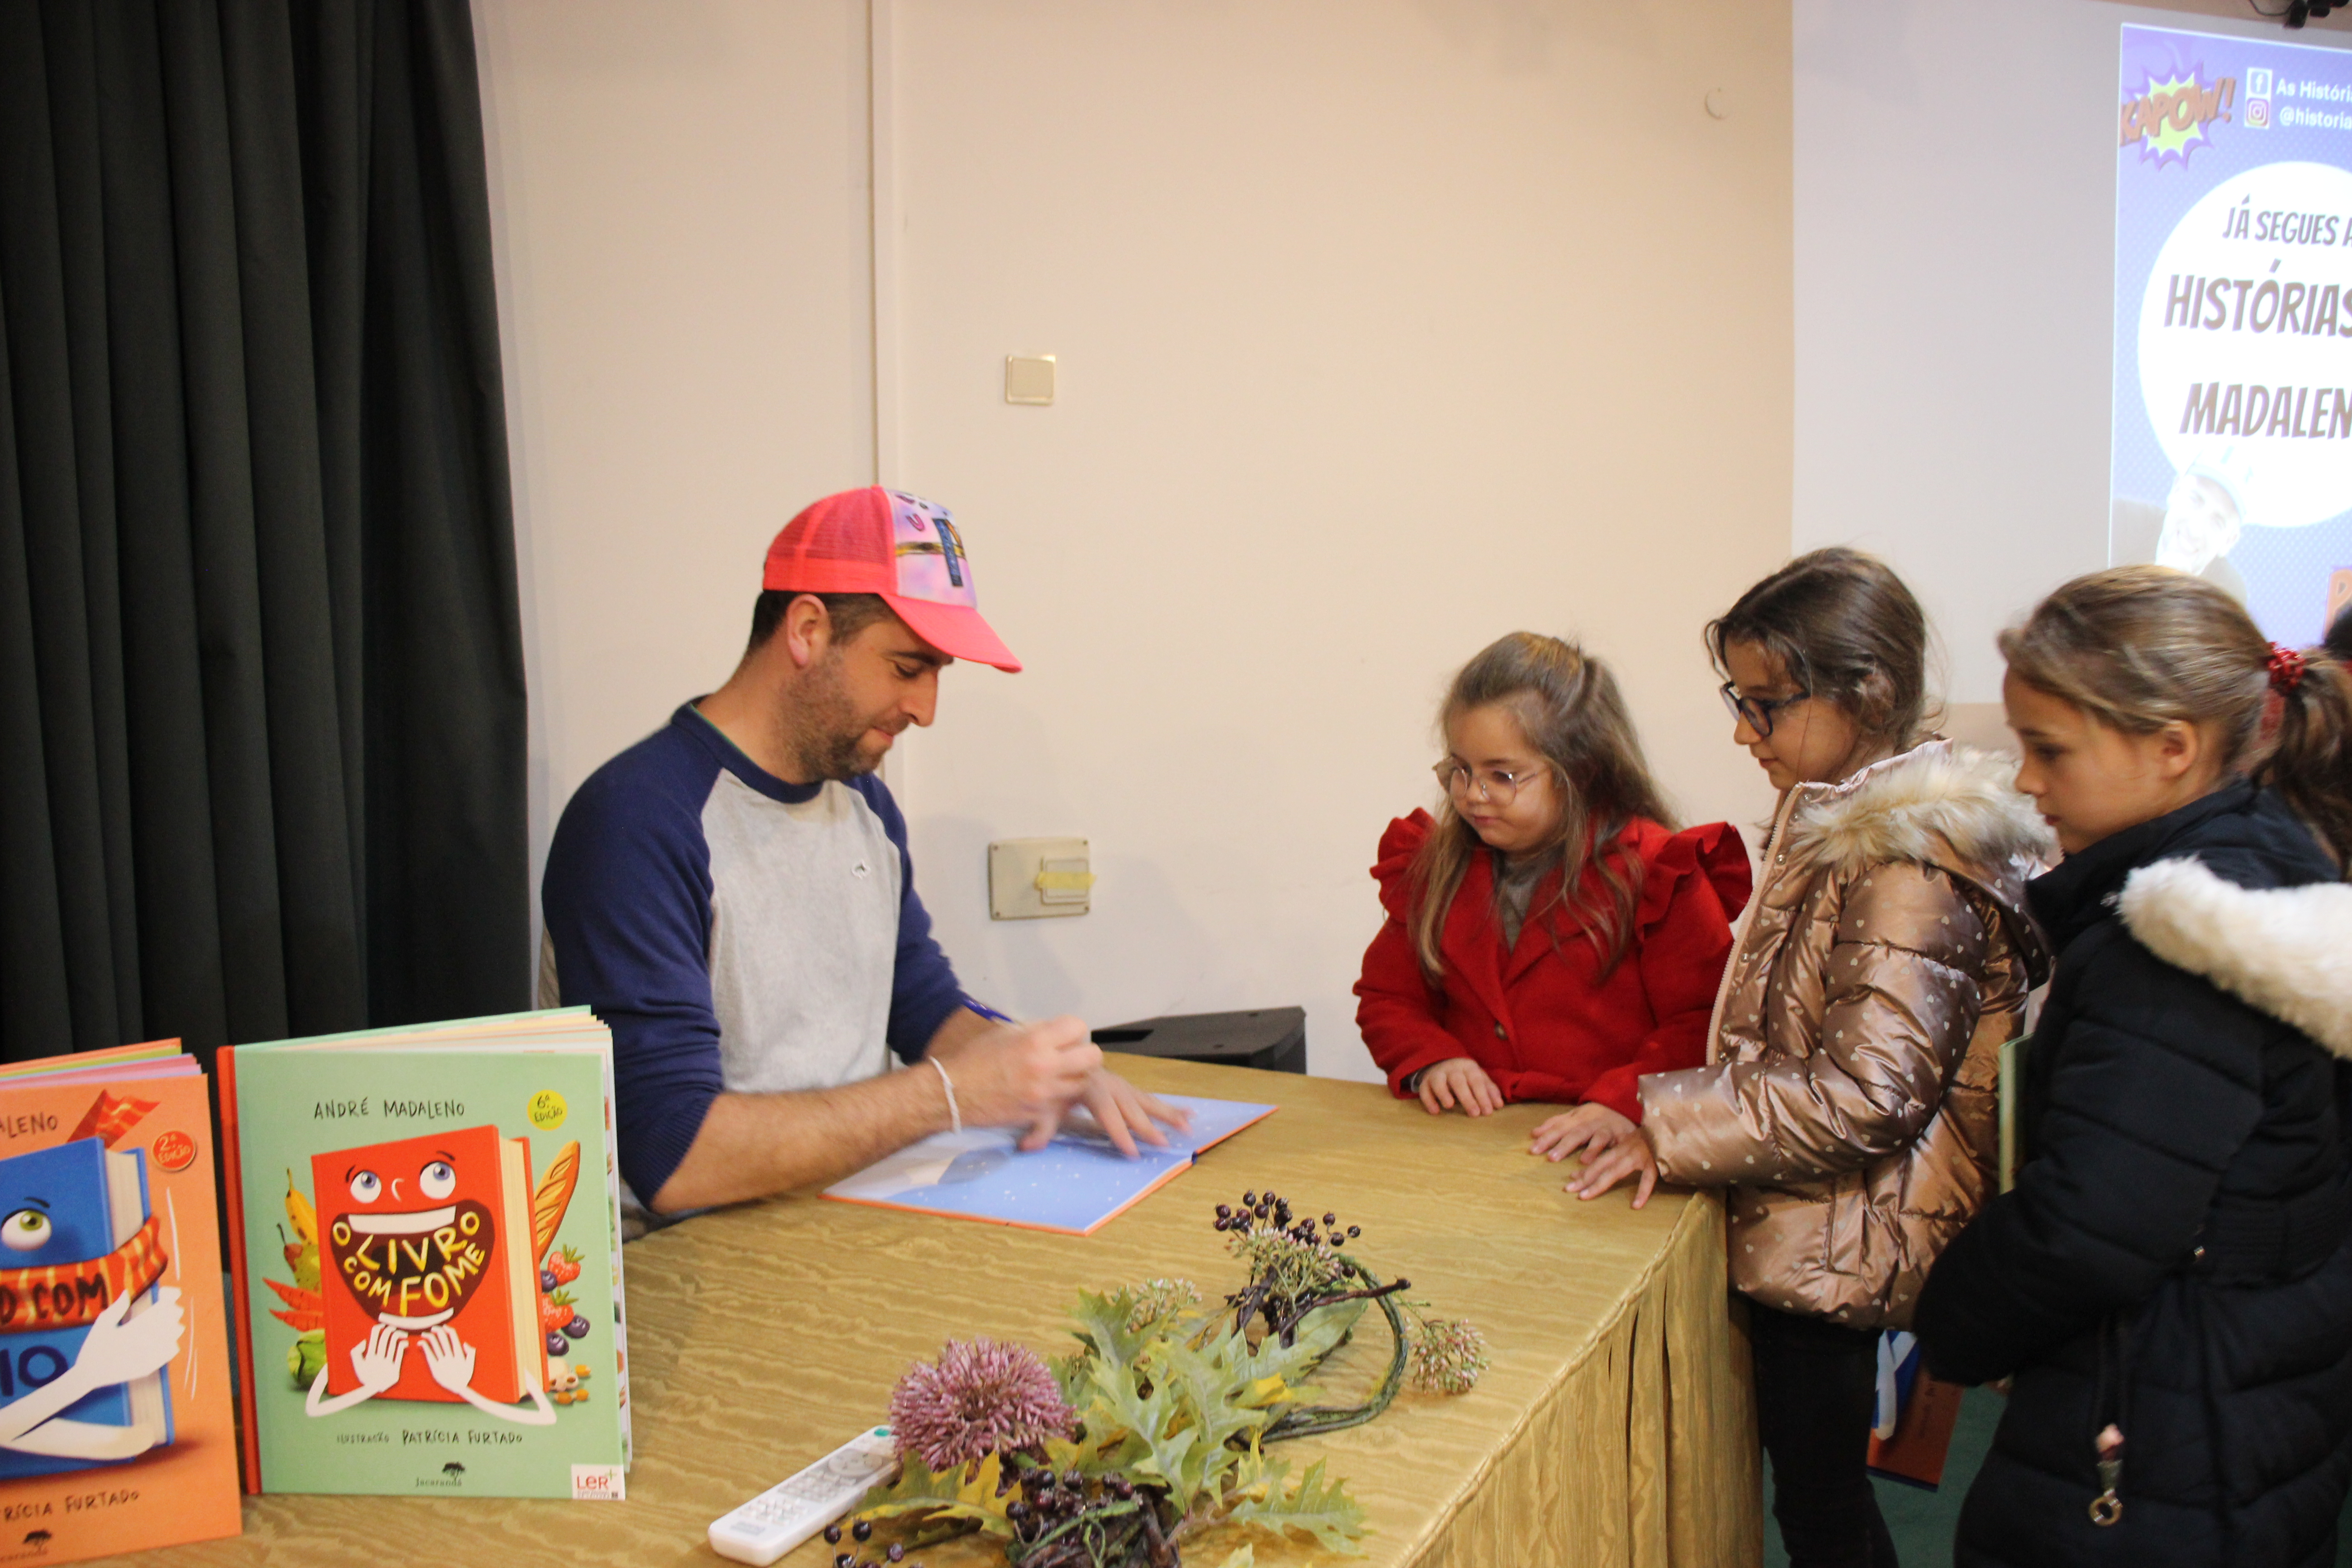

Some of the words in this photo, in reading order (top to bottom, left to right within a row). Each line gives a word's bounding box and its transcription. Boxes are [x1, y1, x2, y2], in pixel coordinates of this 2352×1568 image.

[2276, 78, 2296, 97] As
[2299, 80, 2352, 103] Históri
[2222, 193, 2250, 239] JÁ
[2254, 211, 2340, 246] SEGUES
[2179, 382, 2352, 440] MADALEN
[314, 1096, 369, 1120] ANDRÉ
[384, 1098, 465, 1120] MADALENO
[534, 1105, 563, 1122] EDIÇÃO
[333, 1221, 351, 1246] O
[356, 1211, 480, 1274] LIVRO
[32, 1272, 108, 1319] COM
[344, 1256, 392, 1307] COM
[399, 1242, 485, 1317] FOME
[402, 1429, 460, 1446] PATRÍCIA
[468, 1429, 523, 1445] FURTADO
[65, 1489, 139, 1514] FURTADO
